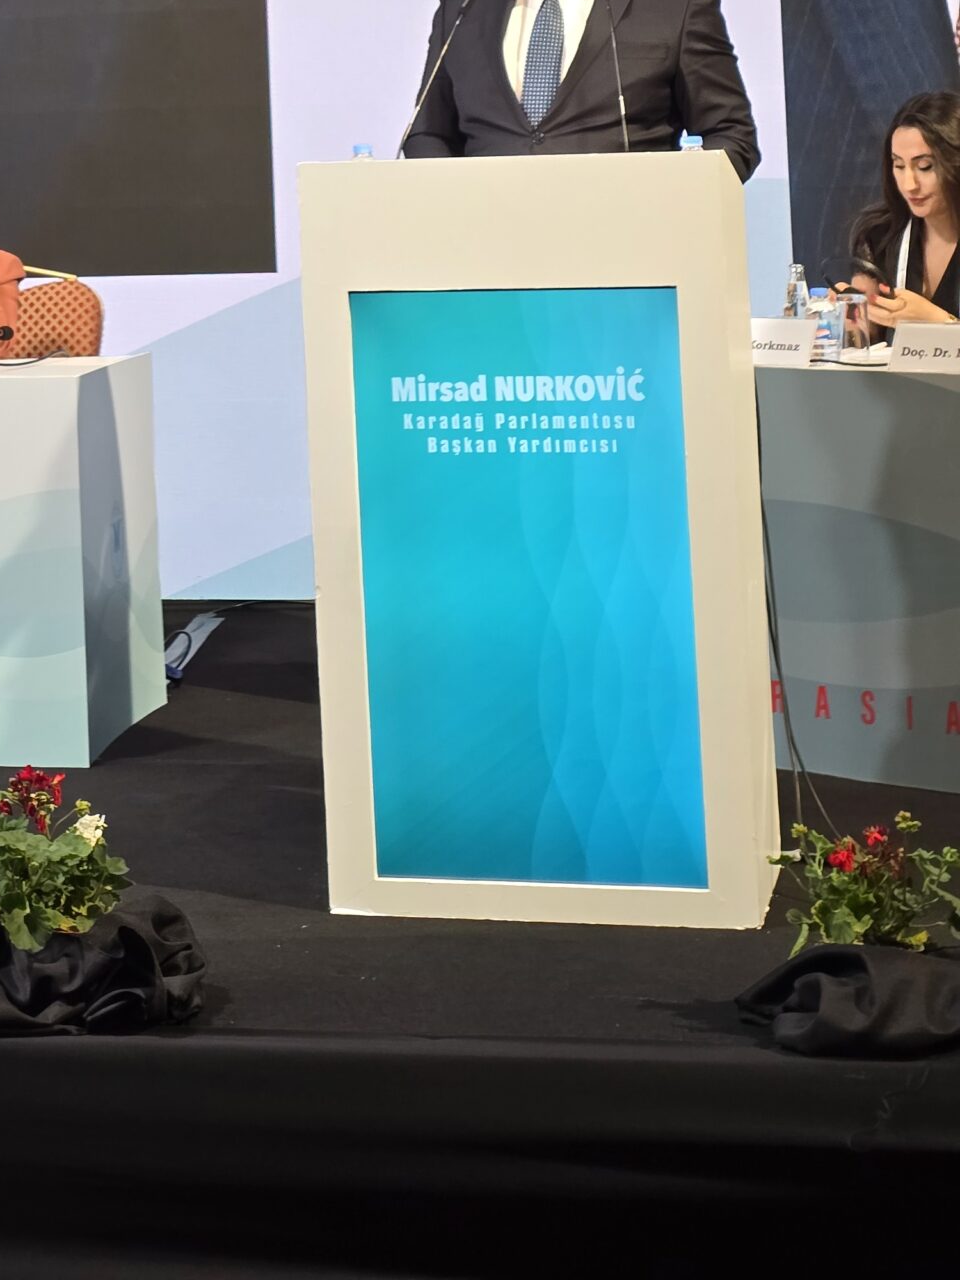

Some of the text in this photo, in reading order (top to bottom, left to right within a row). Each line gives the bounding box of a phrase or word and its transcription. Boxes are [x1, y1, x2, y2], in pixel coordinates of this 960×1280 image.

[901, 346, 928, 360] Doç.
[933, 347, 952, 358] Dr.
[391, 366, 645, 402] Mirsad NURKOVİĆ
[403, 413, 636, 431] Karadağ Parlamentosu
[427, 436, 617, 455] Başkan Yardımcısı
